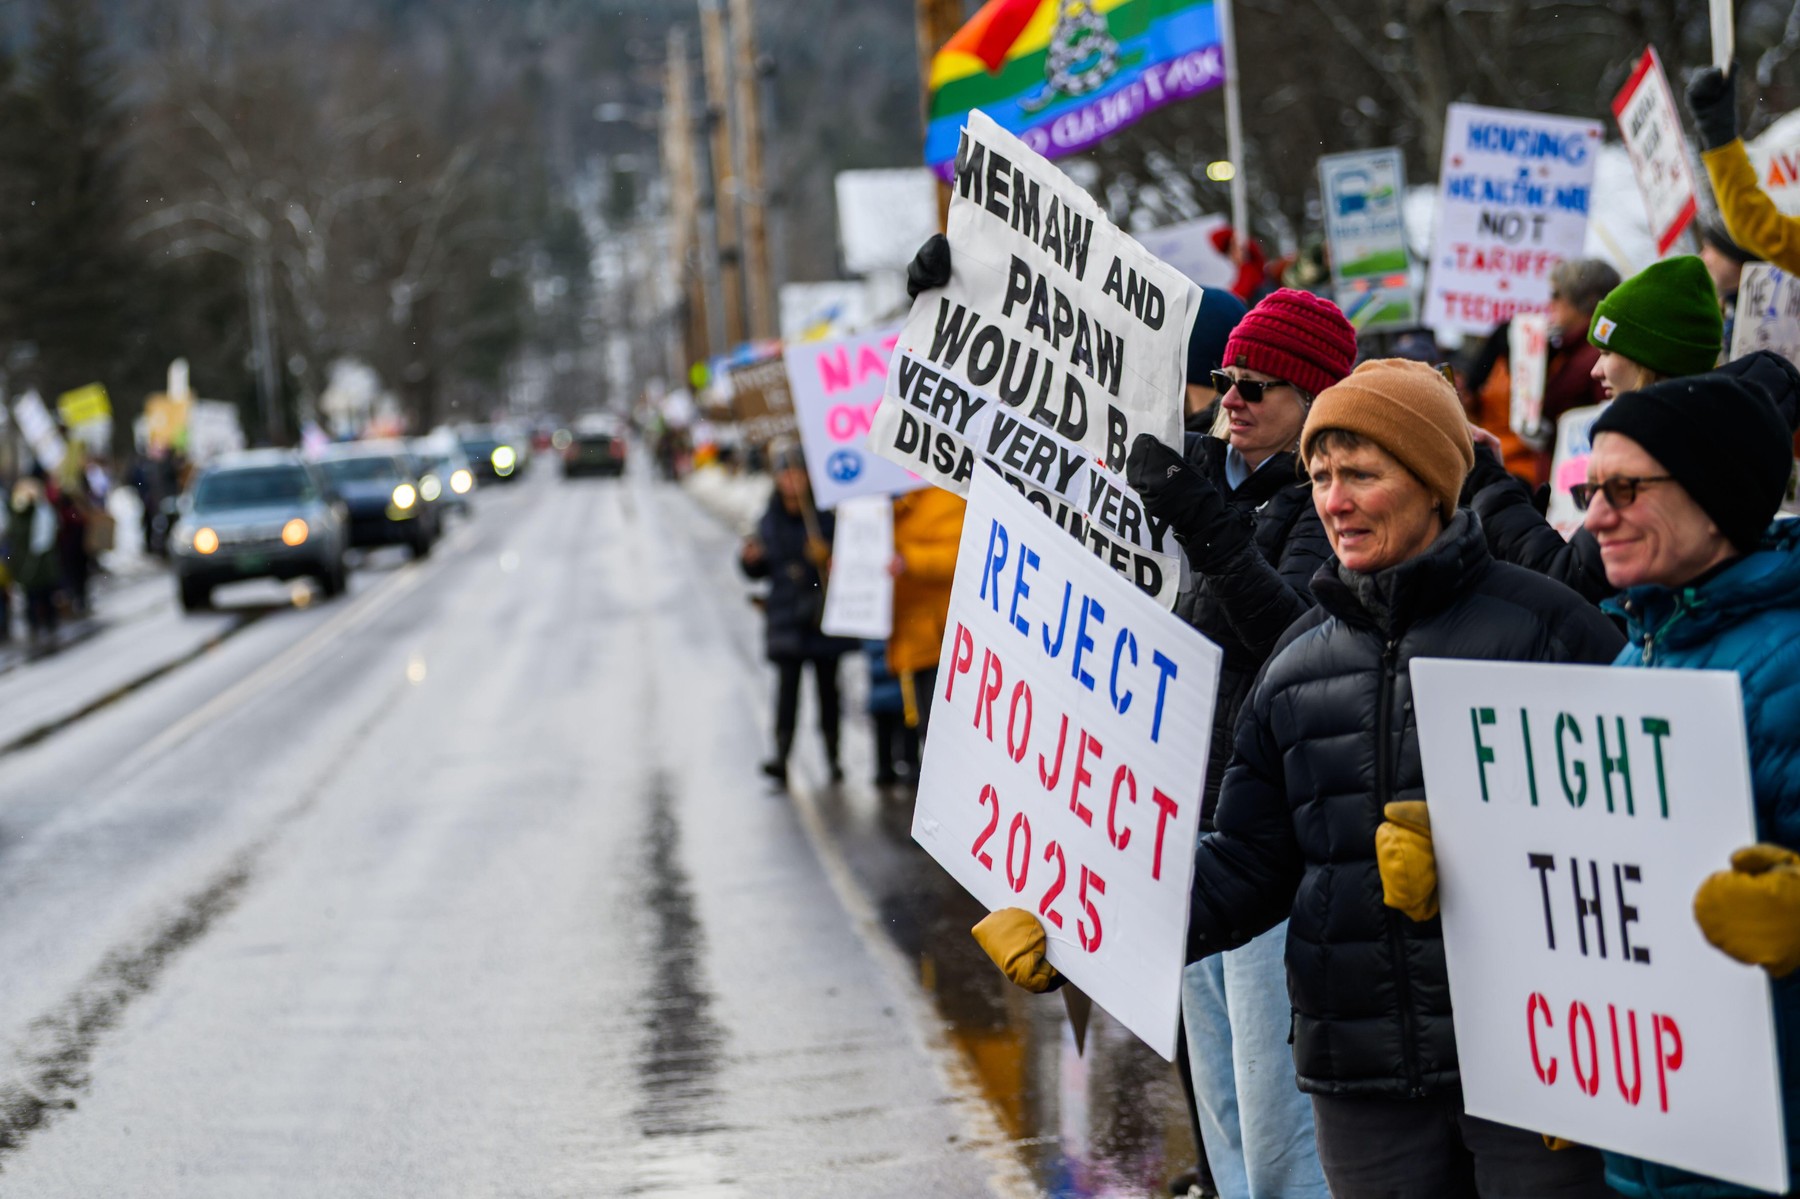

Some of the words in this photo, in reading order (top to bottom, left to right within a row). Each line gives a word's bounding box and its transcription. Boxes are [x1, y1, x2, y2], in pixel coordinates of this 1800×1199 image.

[1467, 121, 1588, 167] HOUSING
[953, 130, 1093, 283] MEMAW
[1102, 254, 1166, 332] AND
[1477, 209, 1549, 244] NOT
[928, 297, 1088, 442] WOULD
[1106, 403, 1129, 474] B
[1001, 253, 1125, 397] PAPAW
[898, 354, 988, 436] VERY
[985, 409, 1087, 496] VERY
[1087, 467, 1173, 554] VERY
[979, 517, 1178, 744] REJECT
[944, 620, 1178, 882] PROJECT
[1470, 706, 1671, 820] FIGHT
[970, 783, 1106, 954] 2025
[1527, 852, 1651, 965] THE
[1526, 991, 1684, 1114] COUP
